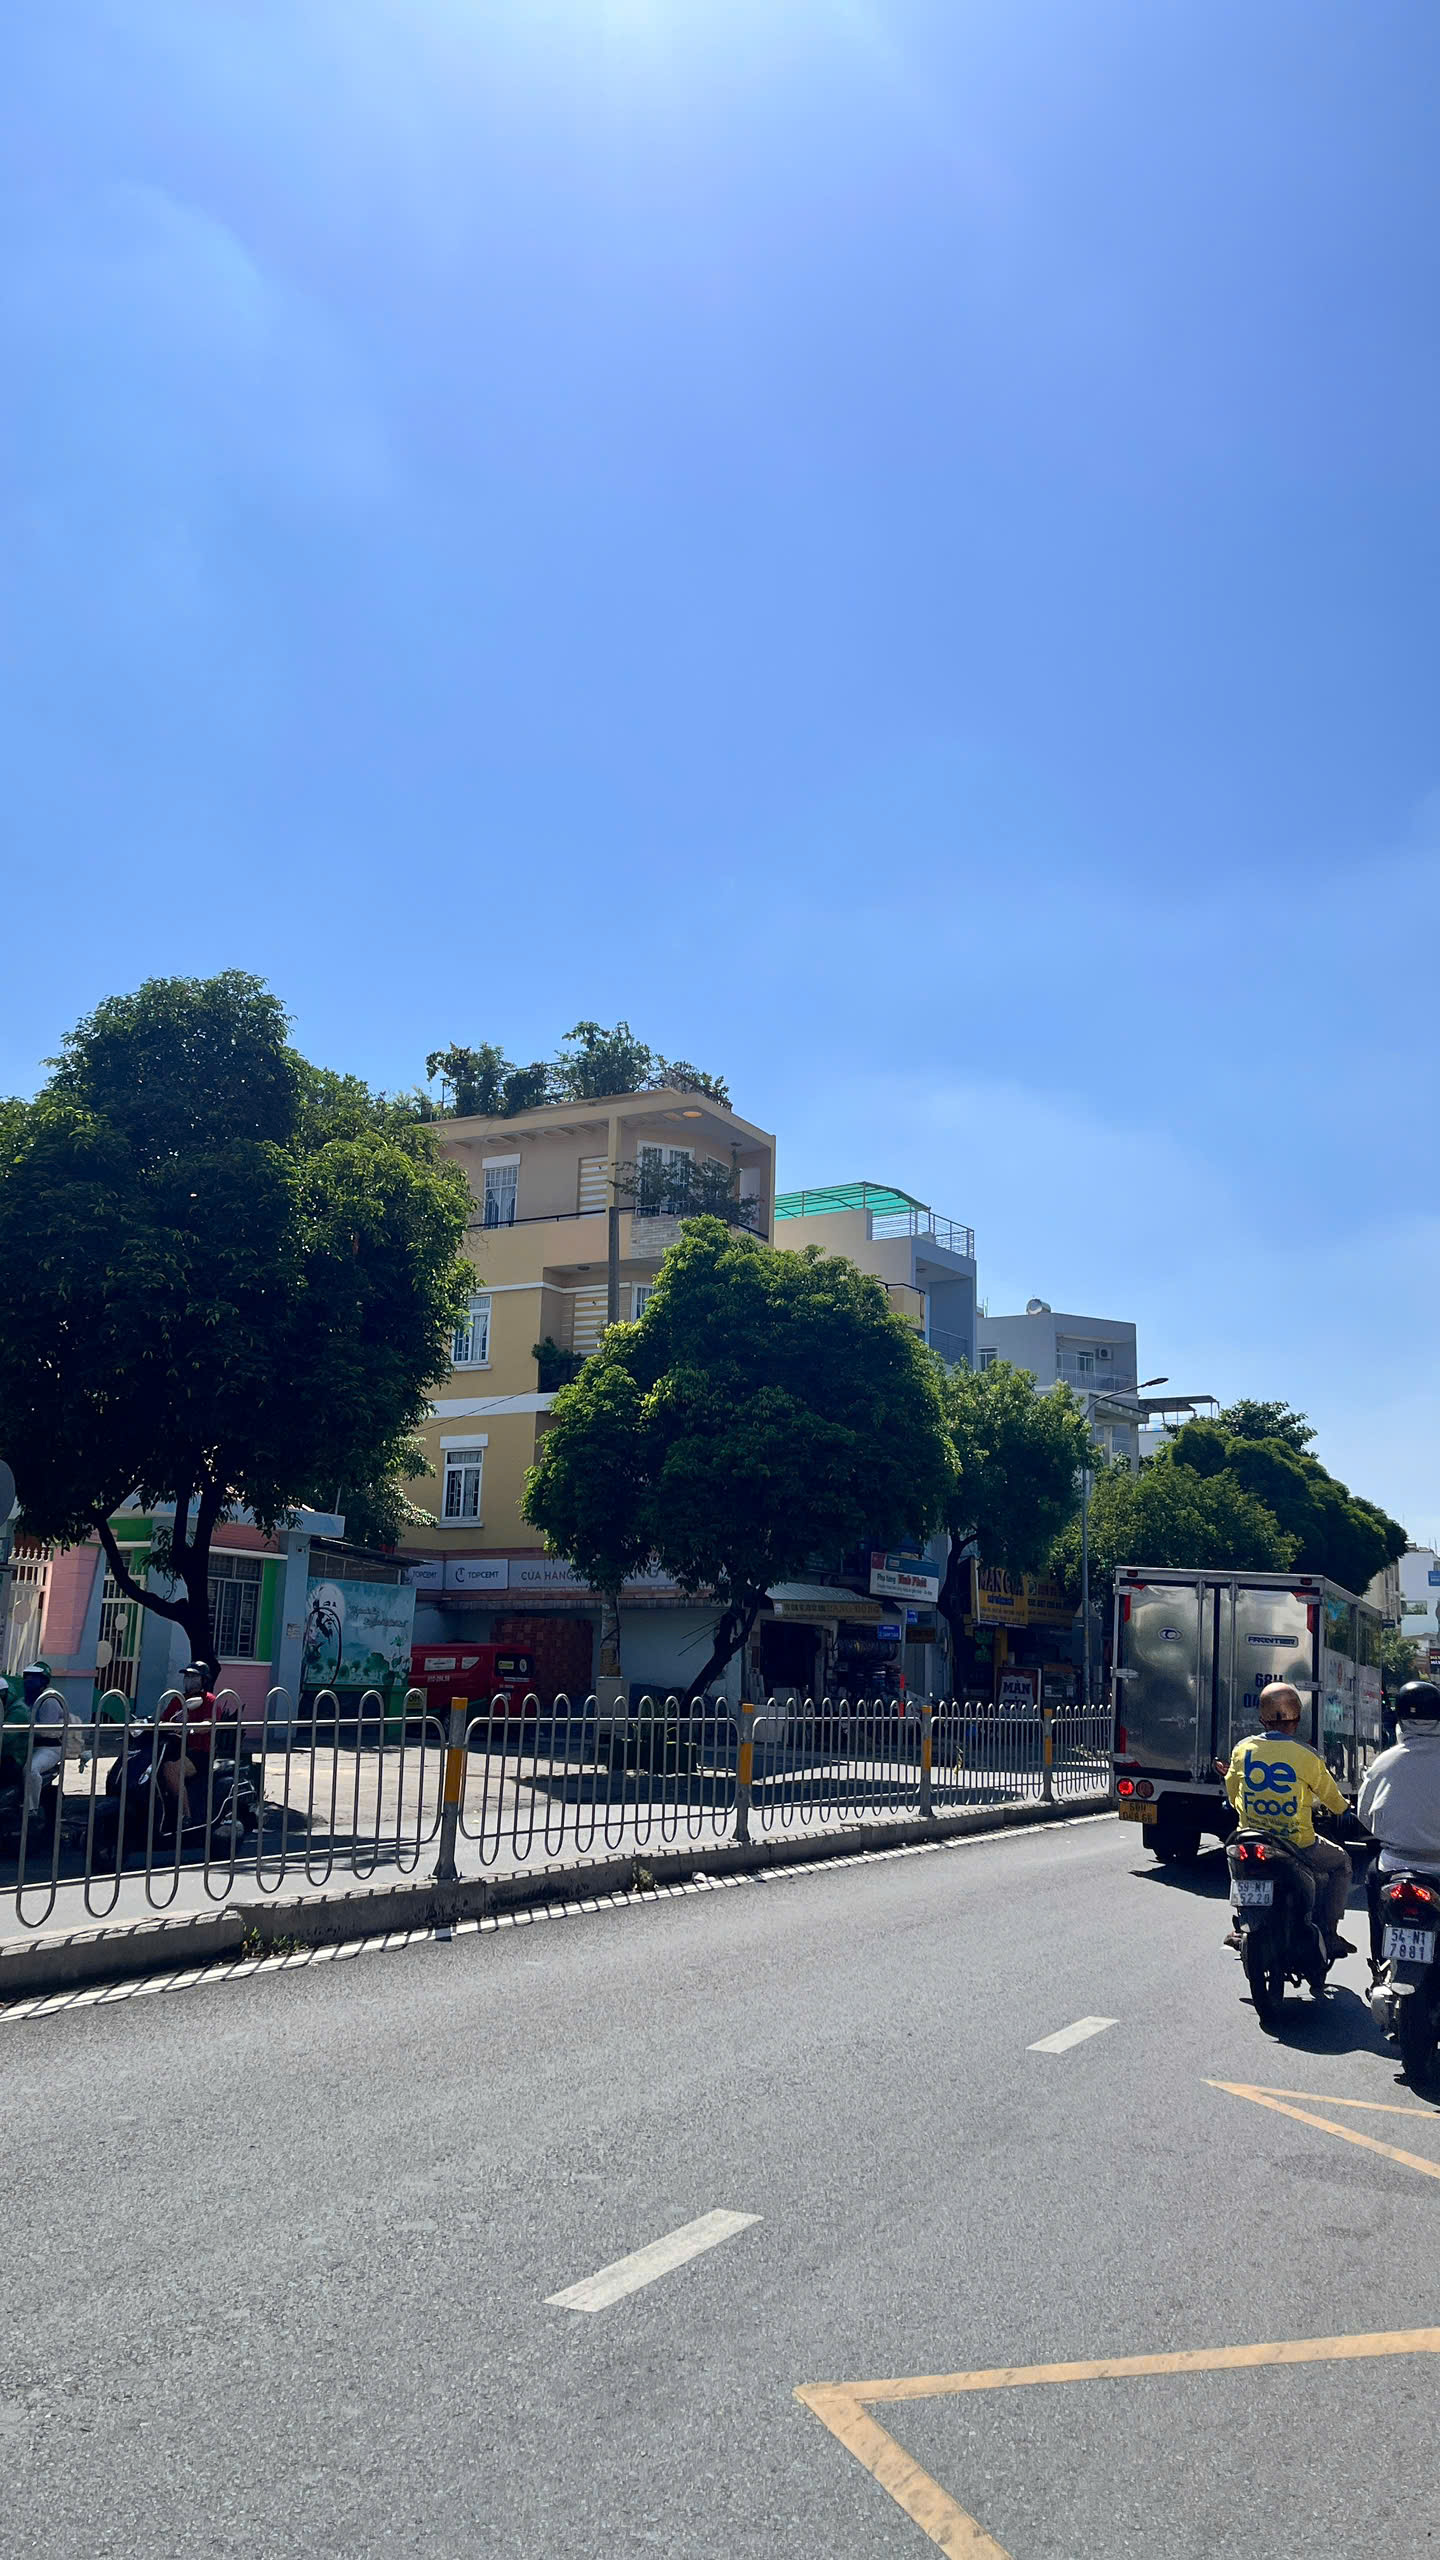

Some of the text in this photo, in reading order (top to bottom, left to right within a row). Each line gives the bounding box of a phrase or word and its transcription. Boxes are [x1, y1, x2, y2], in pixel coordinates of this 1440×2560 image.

[1247, 1636, 1296, 1645] FRONTIER
[1244, 1750, 1297, 1793] be
[1244, 1792, 1298, 1817] Food
[1390, 1943, 1425, 1961] 7881
